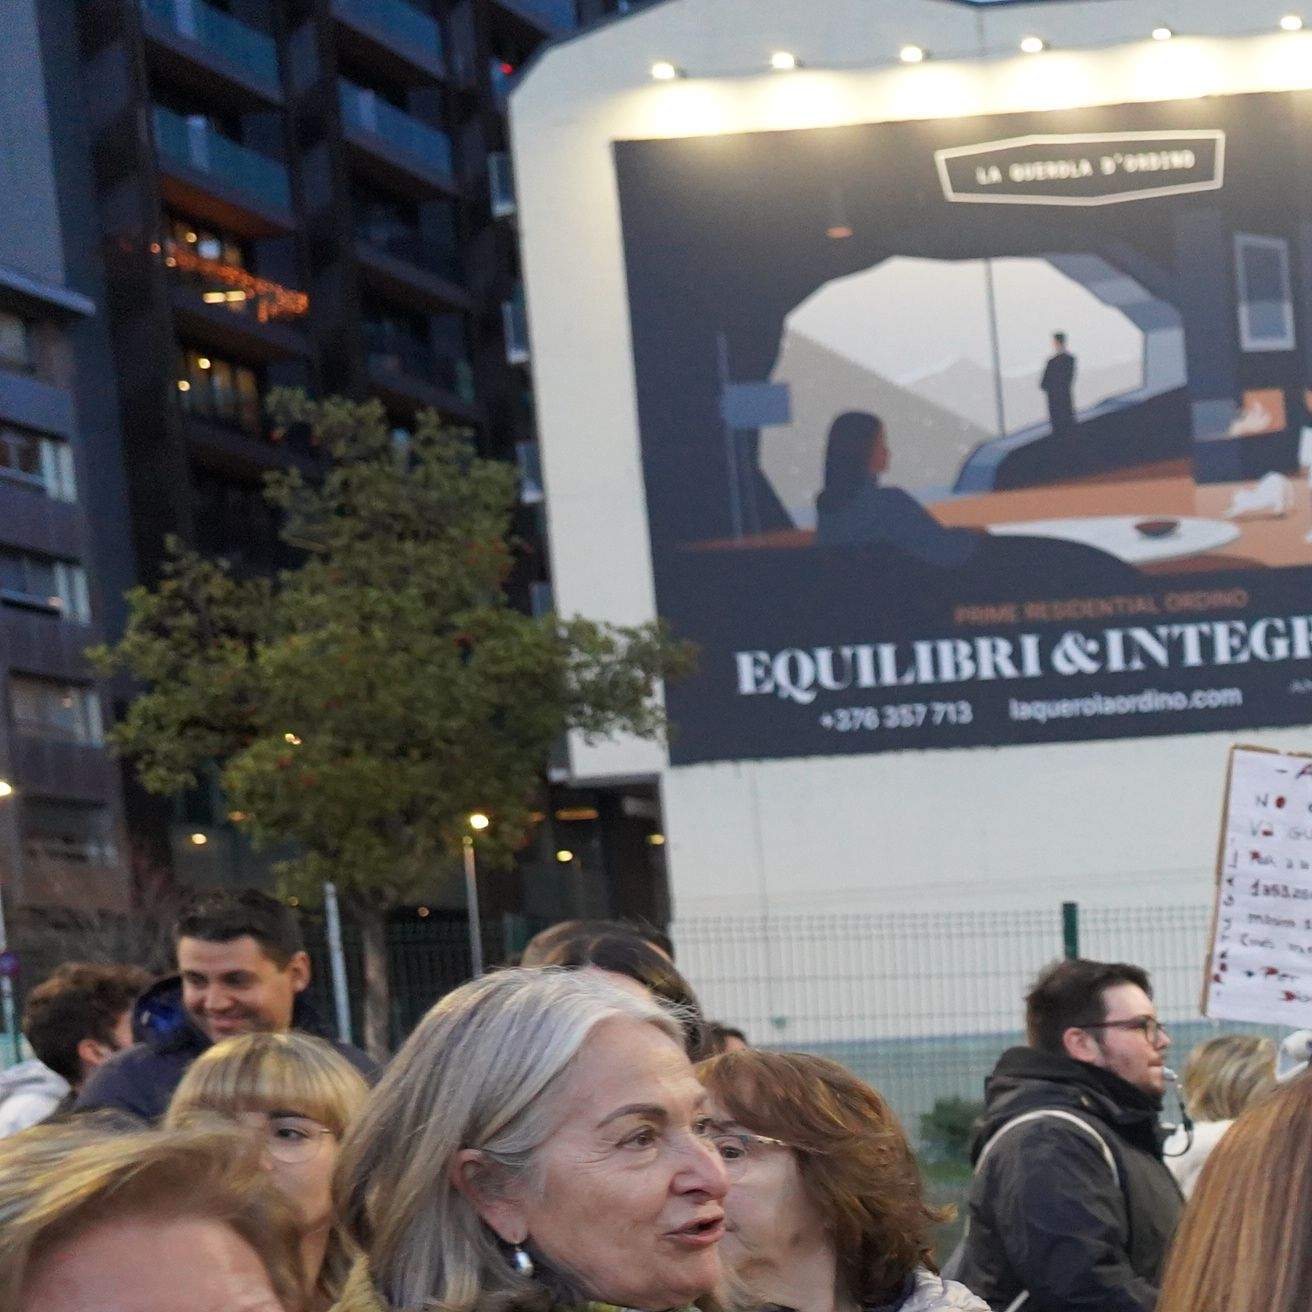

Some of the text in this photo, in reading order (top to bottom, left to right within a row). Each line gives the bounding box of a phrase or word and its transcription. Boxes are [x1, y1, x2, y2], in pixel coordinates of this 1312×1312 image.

[975, 165, 1002, 186] LA
[1009, 159, 1093, 183] QUEROLA
[954, 588, 1248, 624] PRIME RESIDENTIAL ORDINO
[735, 634, 1042, 705] EQUILIBRI
[881, 702, 928, 729] 357
[931, 699, 974, 726] 713
[1008, 687, 1244, 725] laquerolaordino.com
